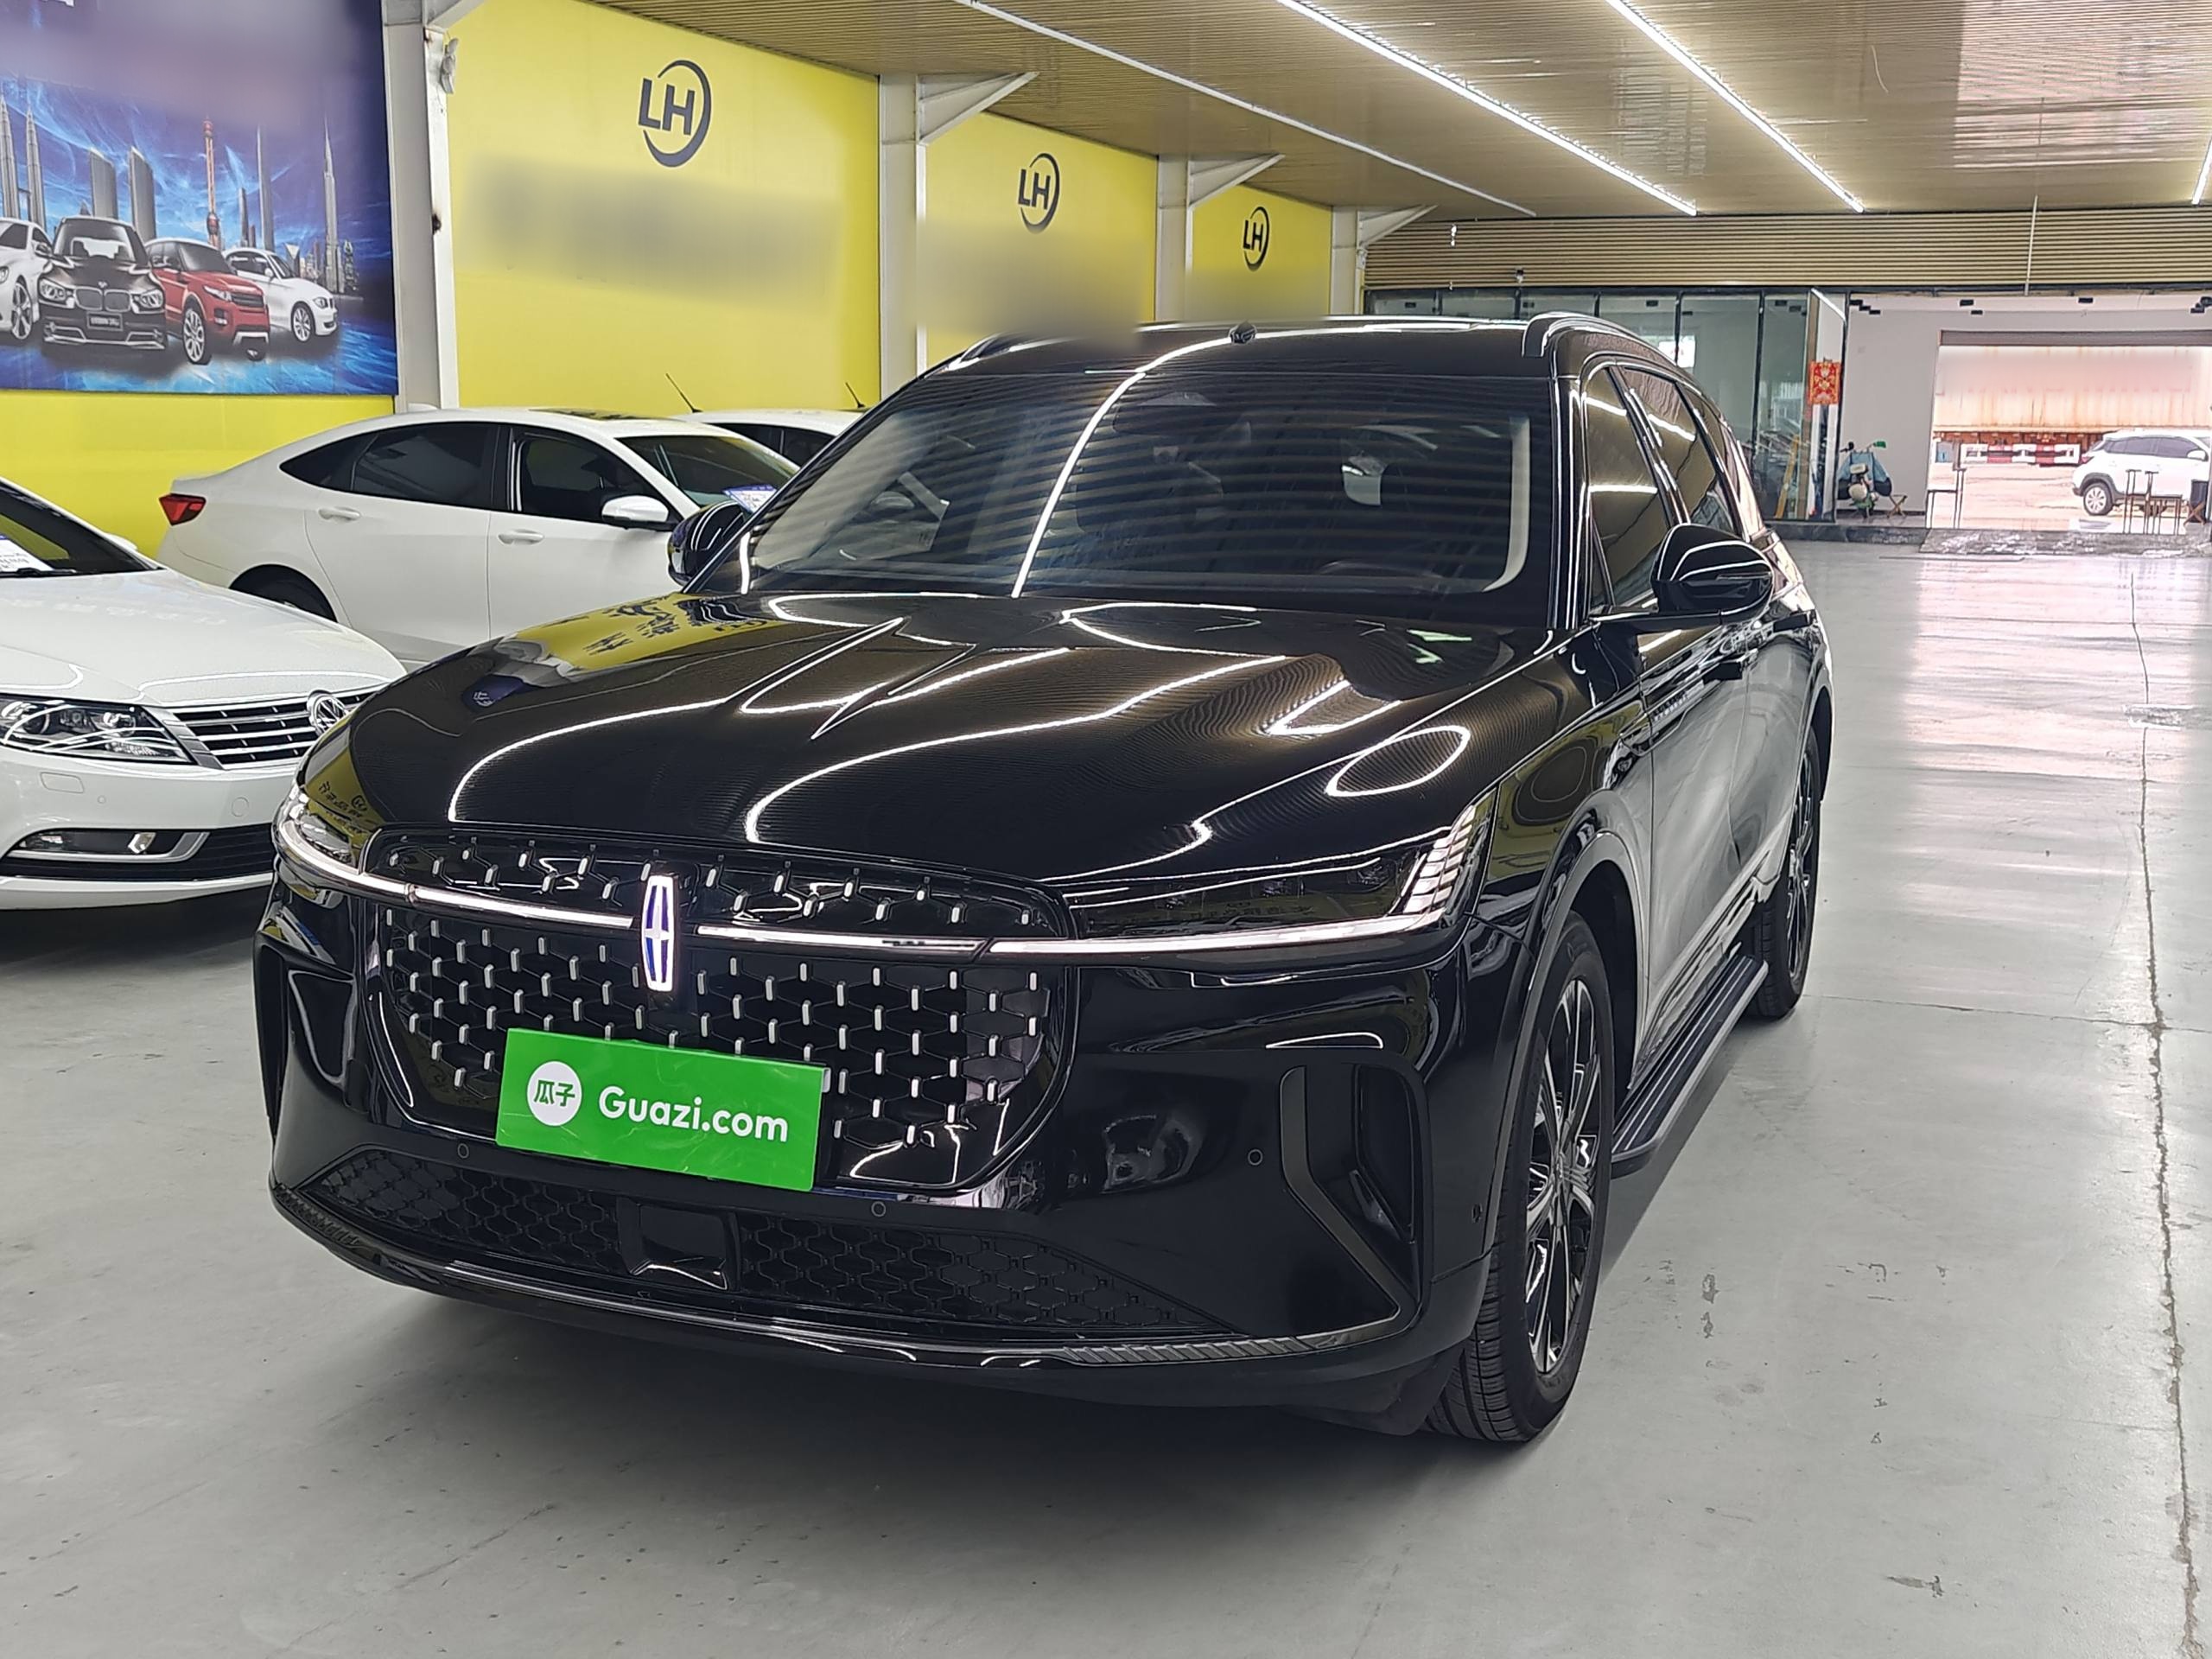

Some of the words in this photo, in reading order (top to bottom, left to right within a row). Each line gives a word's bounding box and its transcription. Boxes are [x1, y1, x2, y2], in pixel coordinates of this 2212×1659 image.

[639, 77, 696, 137] LH
[1018, 168, 1051, 210] LH
[1243, 219, 1264, 253] LH
[533, 1079, 575, 1107] 瓜子
[598, 1085, 788, 1142] Guazi.com
